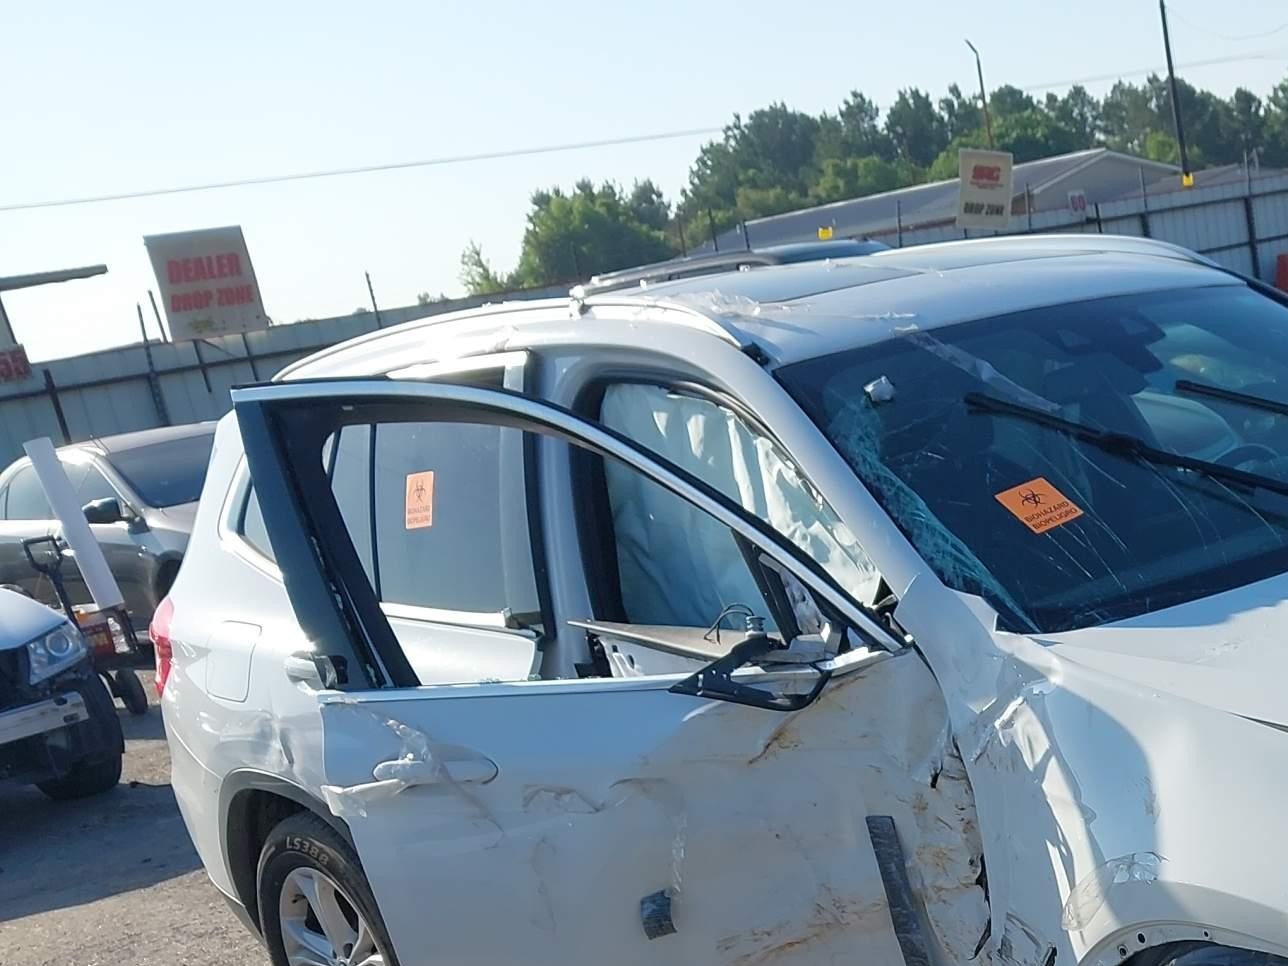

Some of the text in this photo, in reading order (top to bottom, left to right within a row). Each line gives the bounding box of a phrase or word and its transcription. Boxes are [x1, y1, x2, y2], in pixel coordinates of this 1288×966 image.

[167, 252, 241, 284] DEALER
[171, 284, 254, 313] DROP ZONE
